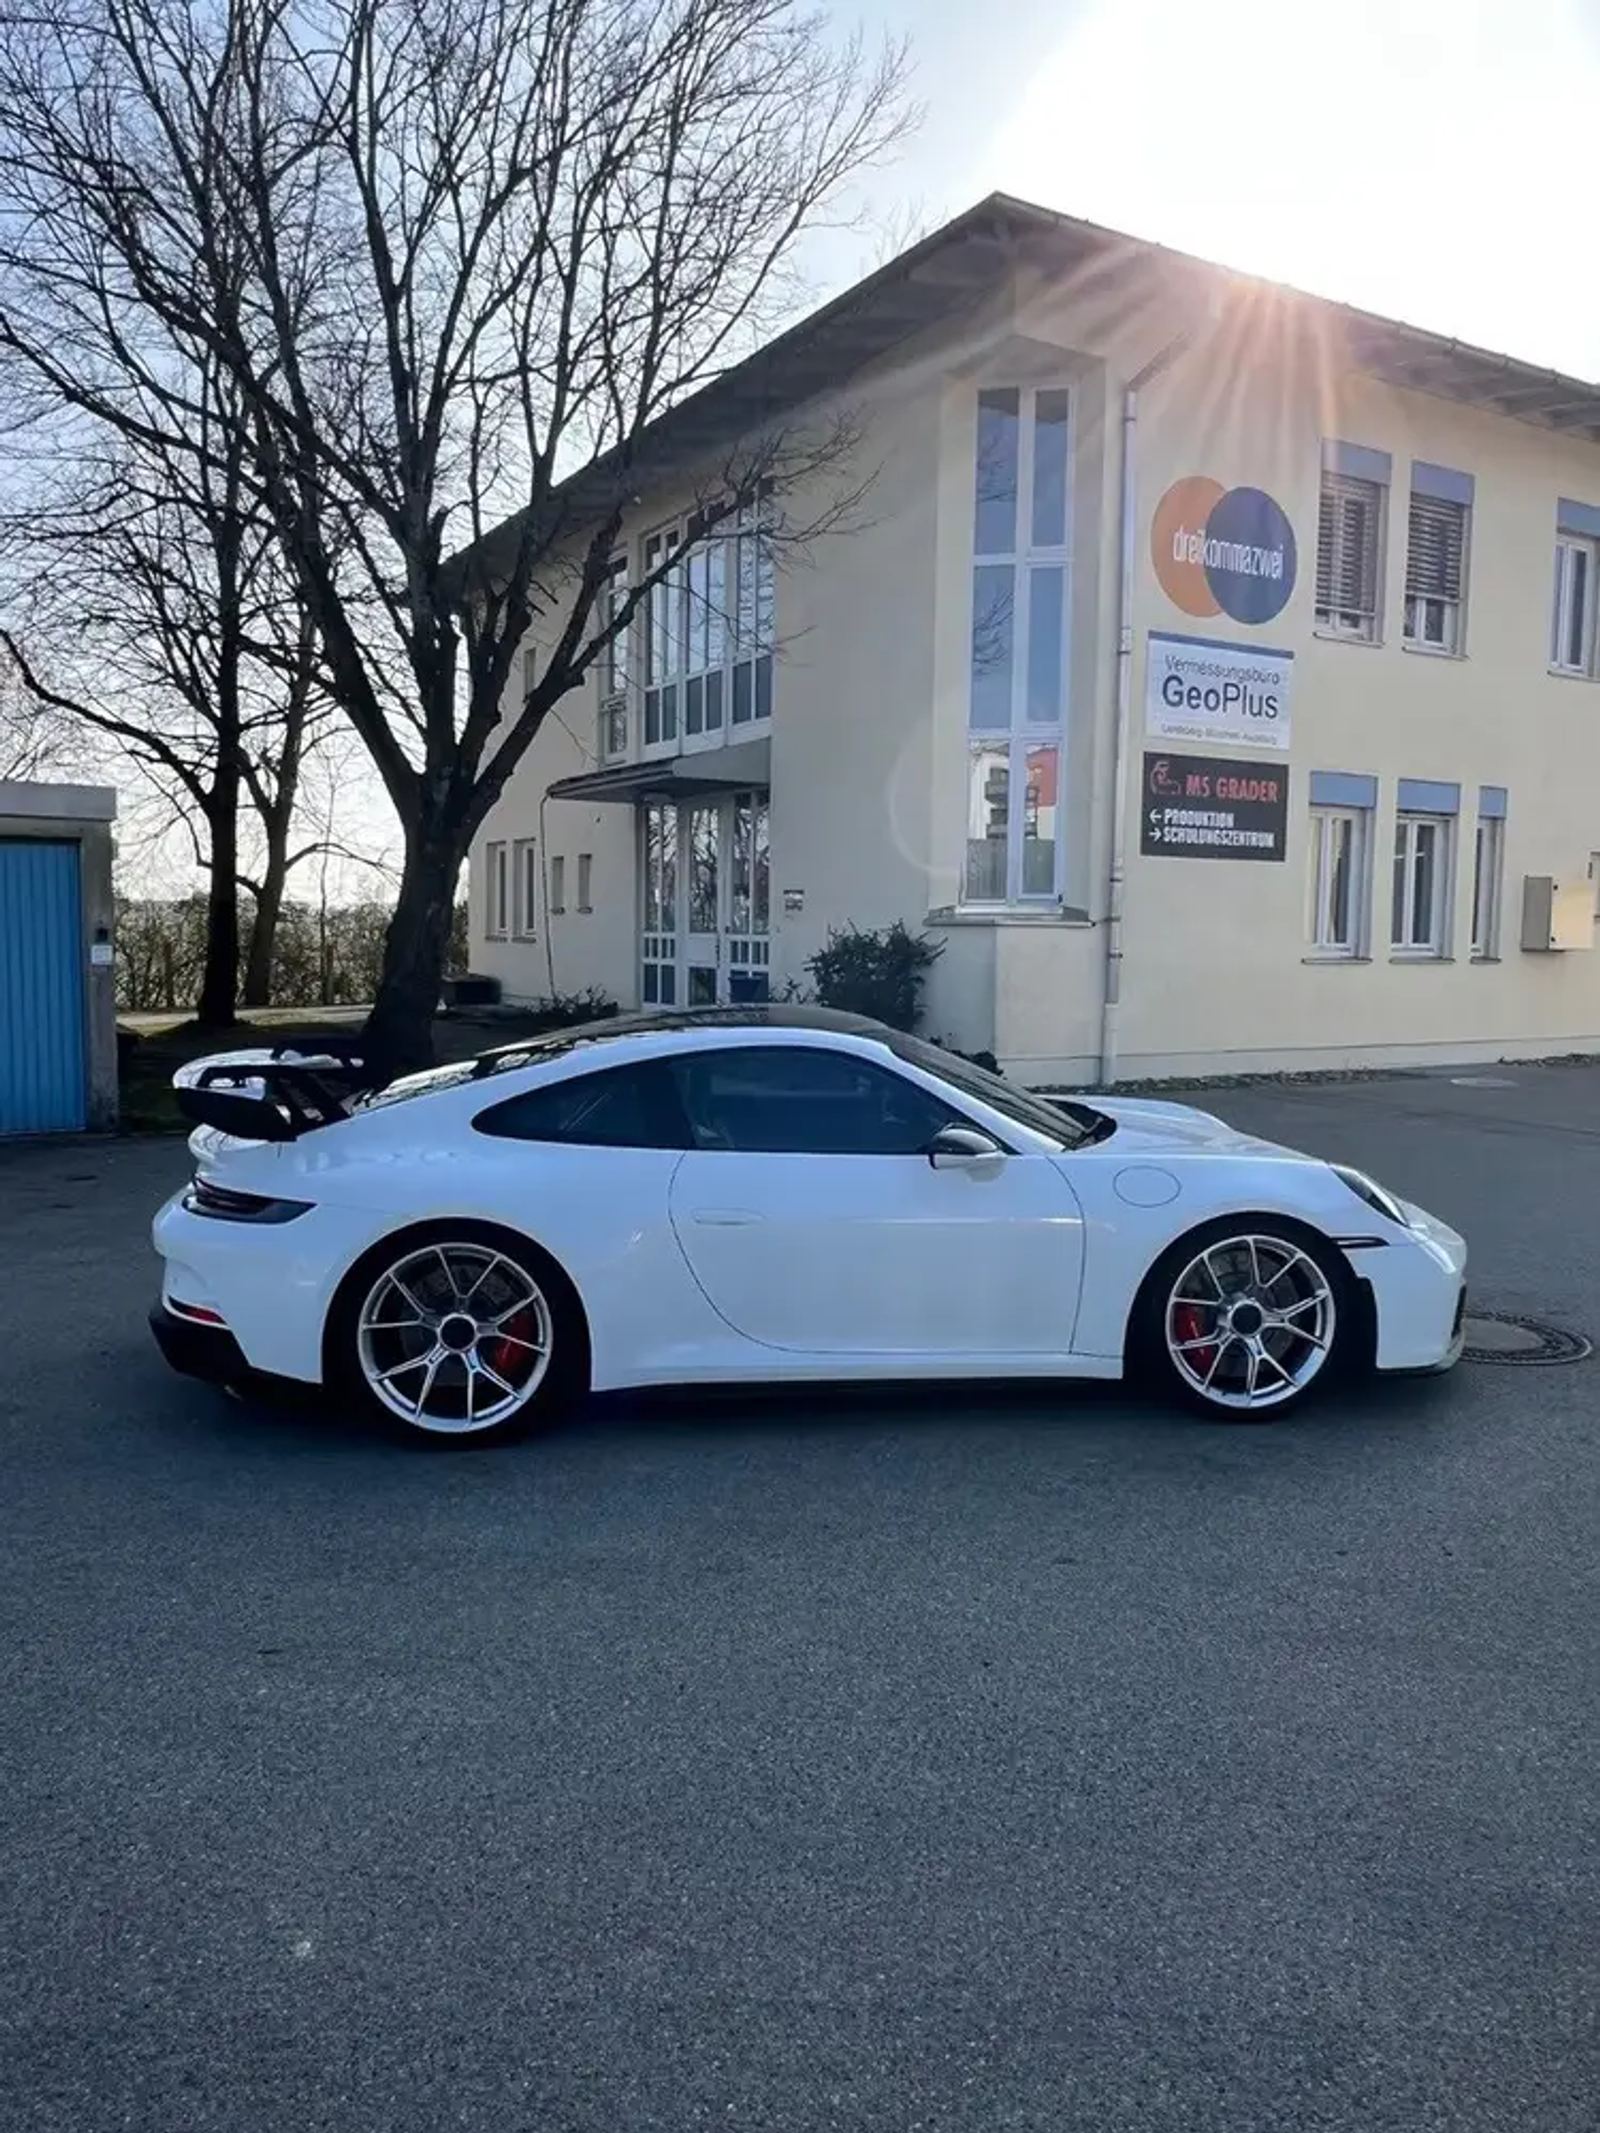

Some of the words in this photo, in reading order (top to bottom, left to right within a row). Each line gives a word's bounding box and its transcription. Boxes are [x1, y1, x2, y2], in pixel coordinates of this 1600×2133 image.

[1162, 674, 1279, 719] GeoPlus
[1186, 774, 1210, 797] MS
[1216, 777, 1278, 802] GRADER
[1164, 808, 1234, 827] PRODUKTION
[1164, 826, 1275, 848] SCHULUNGSZENTRUM
